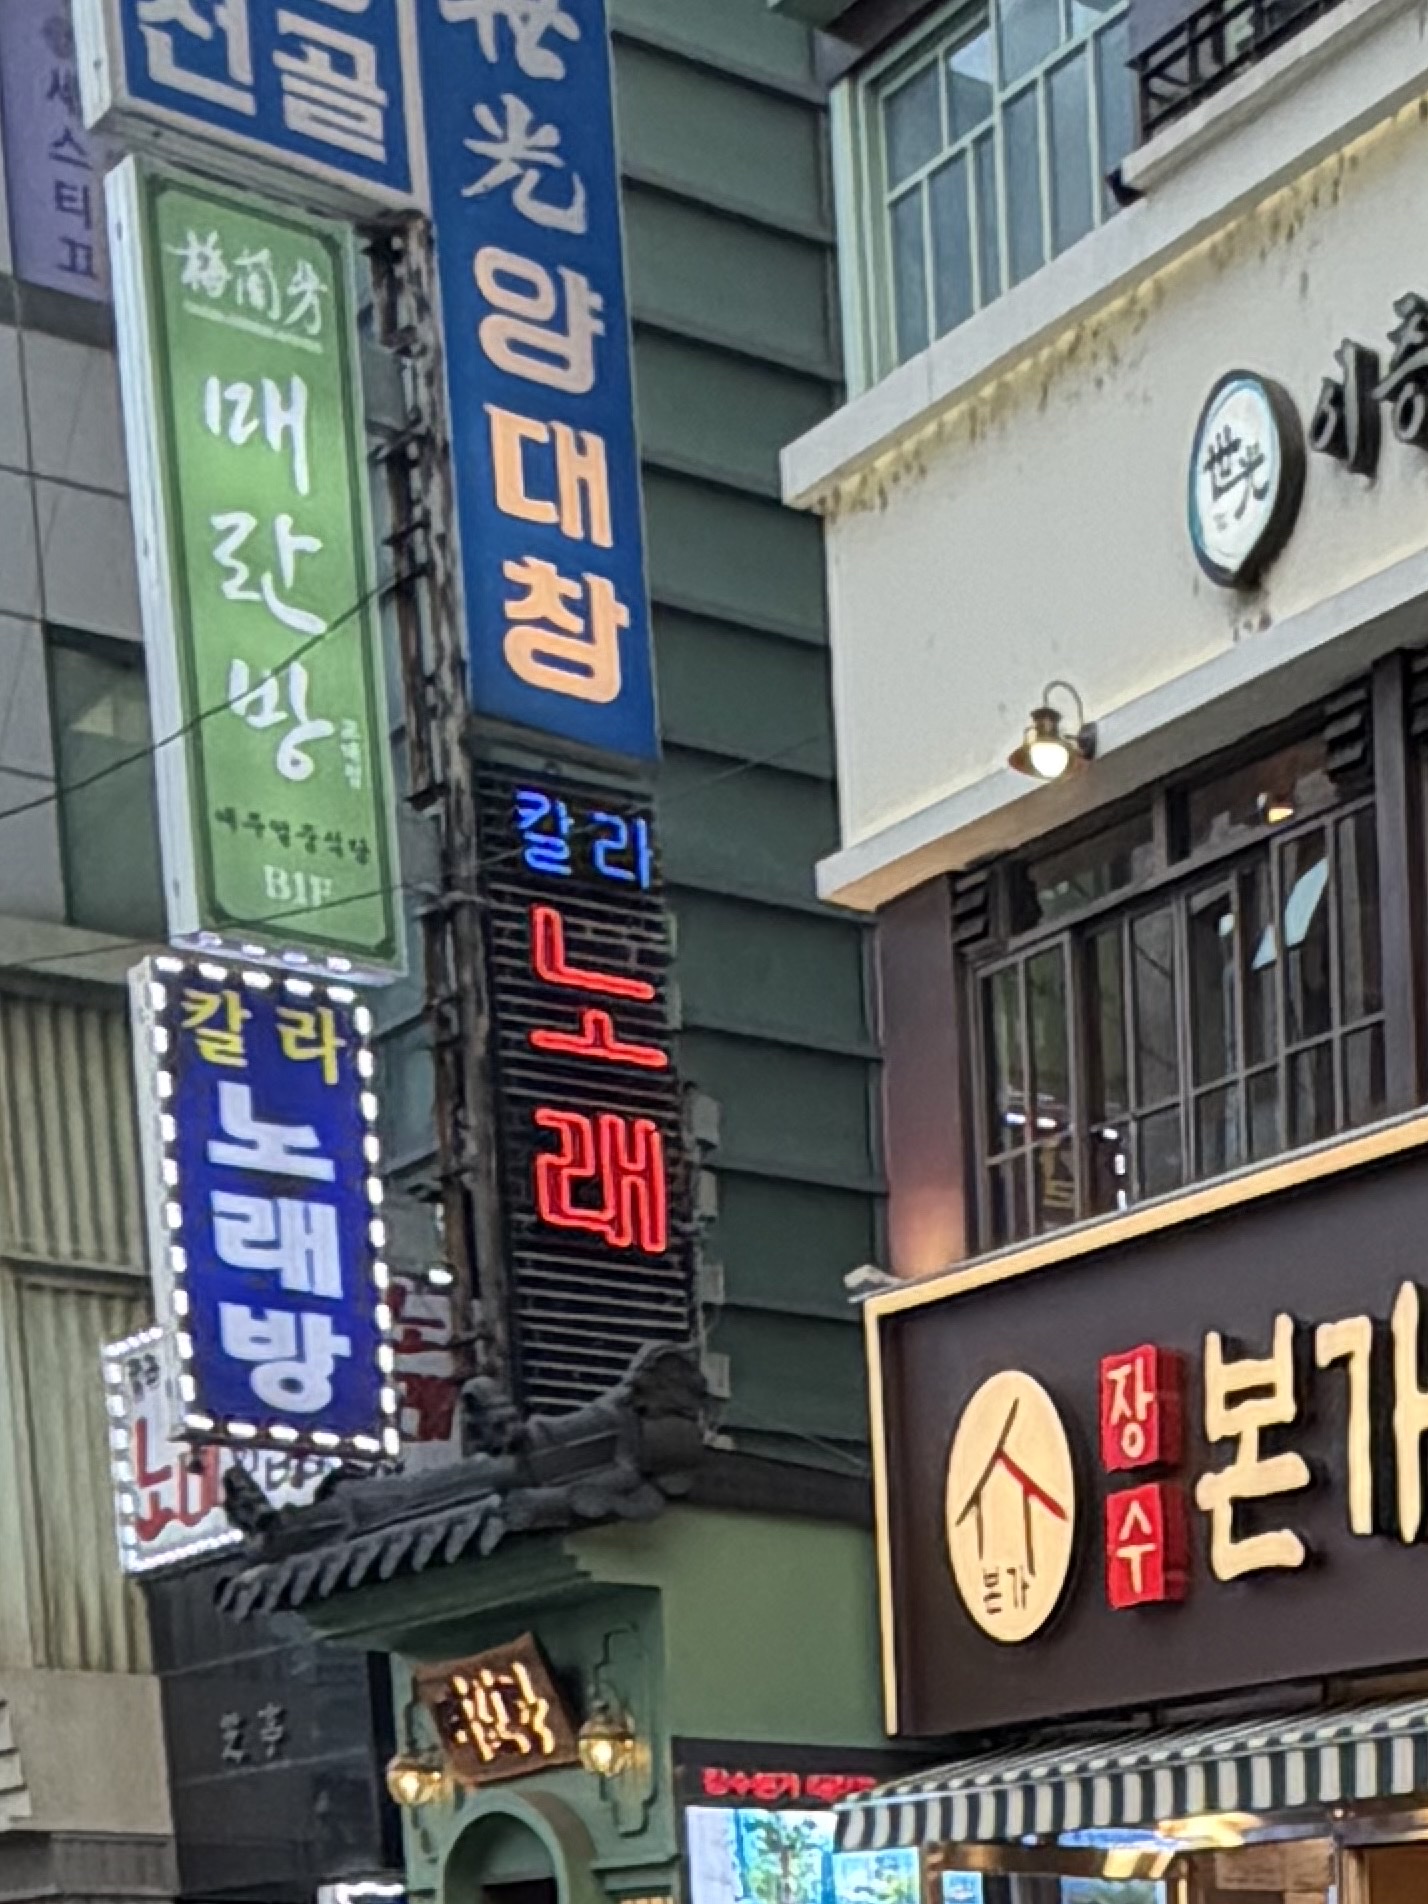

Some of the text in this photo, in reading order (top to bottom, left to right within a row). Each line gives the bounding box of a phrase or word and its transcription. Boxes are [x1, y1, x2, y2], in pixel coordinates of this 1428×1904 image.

[203, 372, 337, 782] 매란방
[263, 864, 334, 908] B1F
[180, 987, 347, 1087] 칼라
[528, 903, 669, 1256] 노래
[205, 1080, 353, 1415] 노래방
[982, 1564, 1030, 1616] 본가
[1109, 1362, 1158, 1597] 장수
